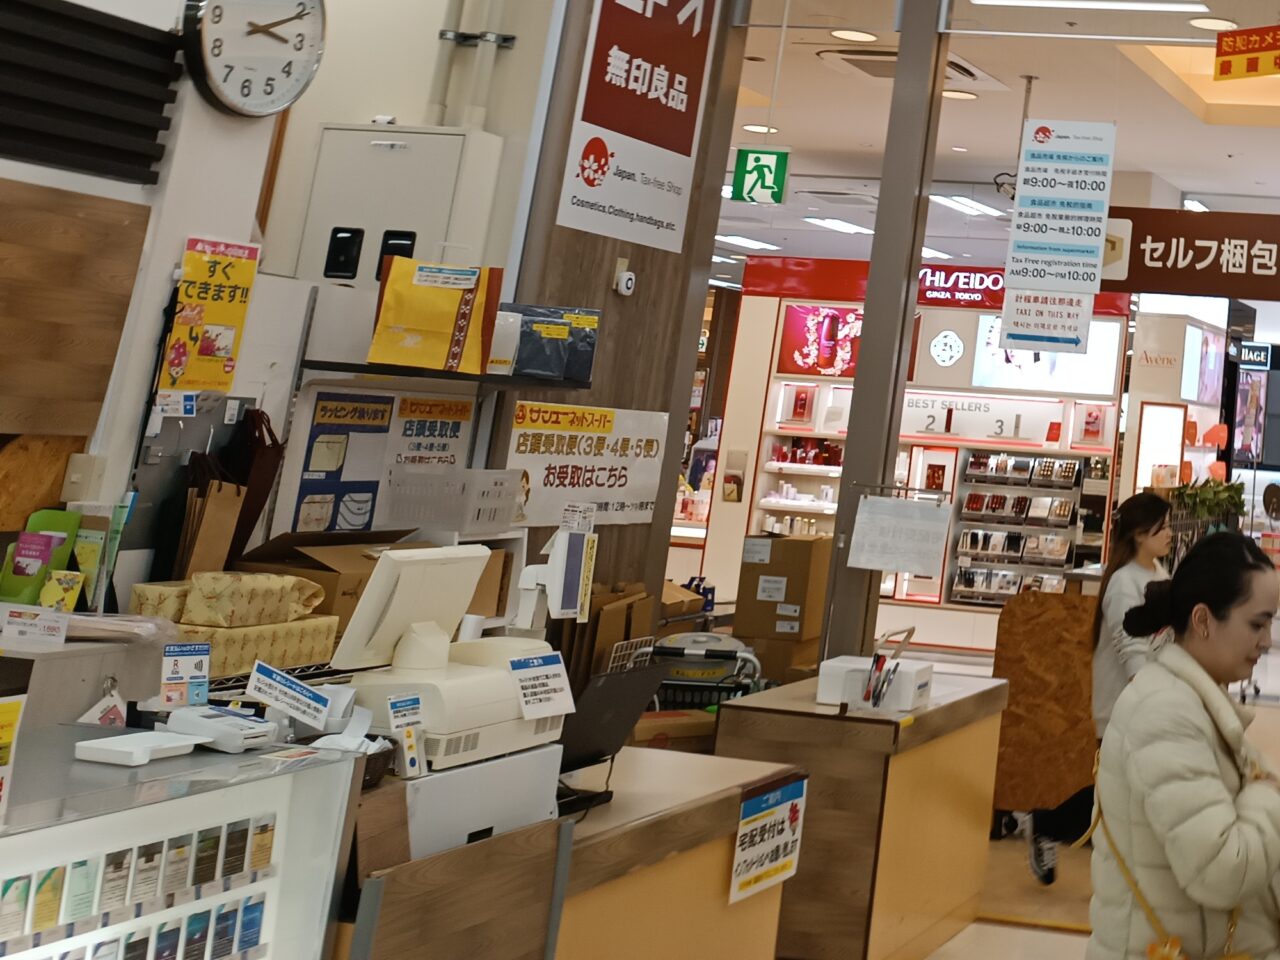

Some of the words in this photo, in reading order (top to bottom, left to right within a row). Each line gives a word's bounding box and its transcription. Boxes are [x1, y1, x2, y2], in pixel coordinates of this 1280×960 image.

[210, 5, 223, 24] 9
[296, 2, 307, 20] 2
[210, 38, 223, 57] 8
[293, 33, 305, 51] 3
[222, 64, 235, 83] 7
[281, 60, 293, 78] 4
[263, 77, 276, 95] 5
[605, 44, 689, 113] 無印良品
[240, 79, 252, 97] 6
[613, 165, 637, 182] Japan.
[666, 181, 683, 196] Shop
[207, 259, 235, 281] すぐ
[1011, 256, 1023, 264] Tax
[1024, 257, 1039, 265] Free
[1041, 258, 1080, 269] registration
[1082, 260, 1098, 268] time
[918, 268, 1004, 290] SHISEIDO
[926, 290, 951, 300] GINZA
[954, 291, 982, 301] TOKYO
[1015, 309, 1032, 317] TAXI
[1036, 310, 1043, 318] ON
[907, 398, 937, 409] BEST
[941, 400, 990, 413] SELLERS
[402, 419, 462, 439] 店頭受取便
[925, 415, 936, 431] 2
[994, 419, 1004, 436] 3
[543, 463, 628, 489] お受取はこちら
